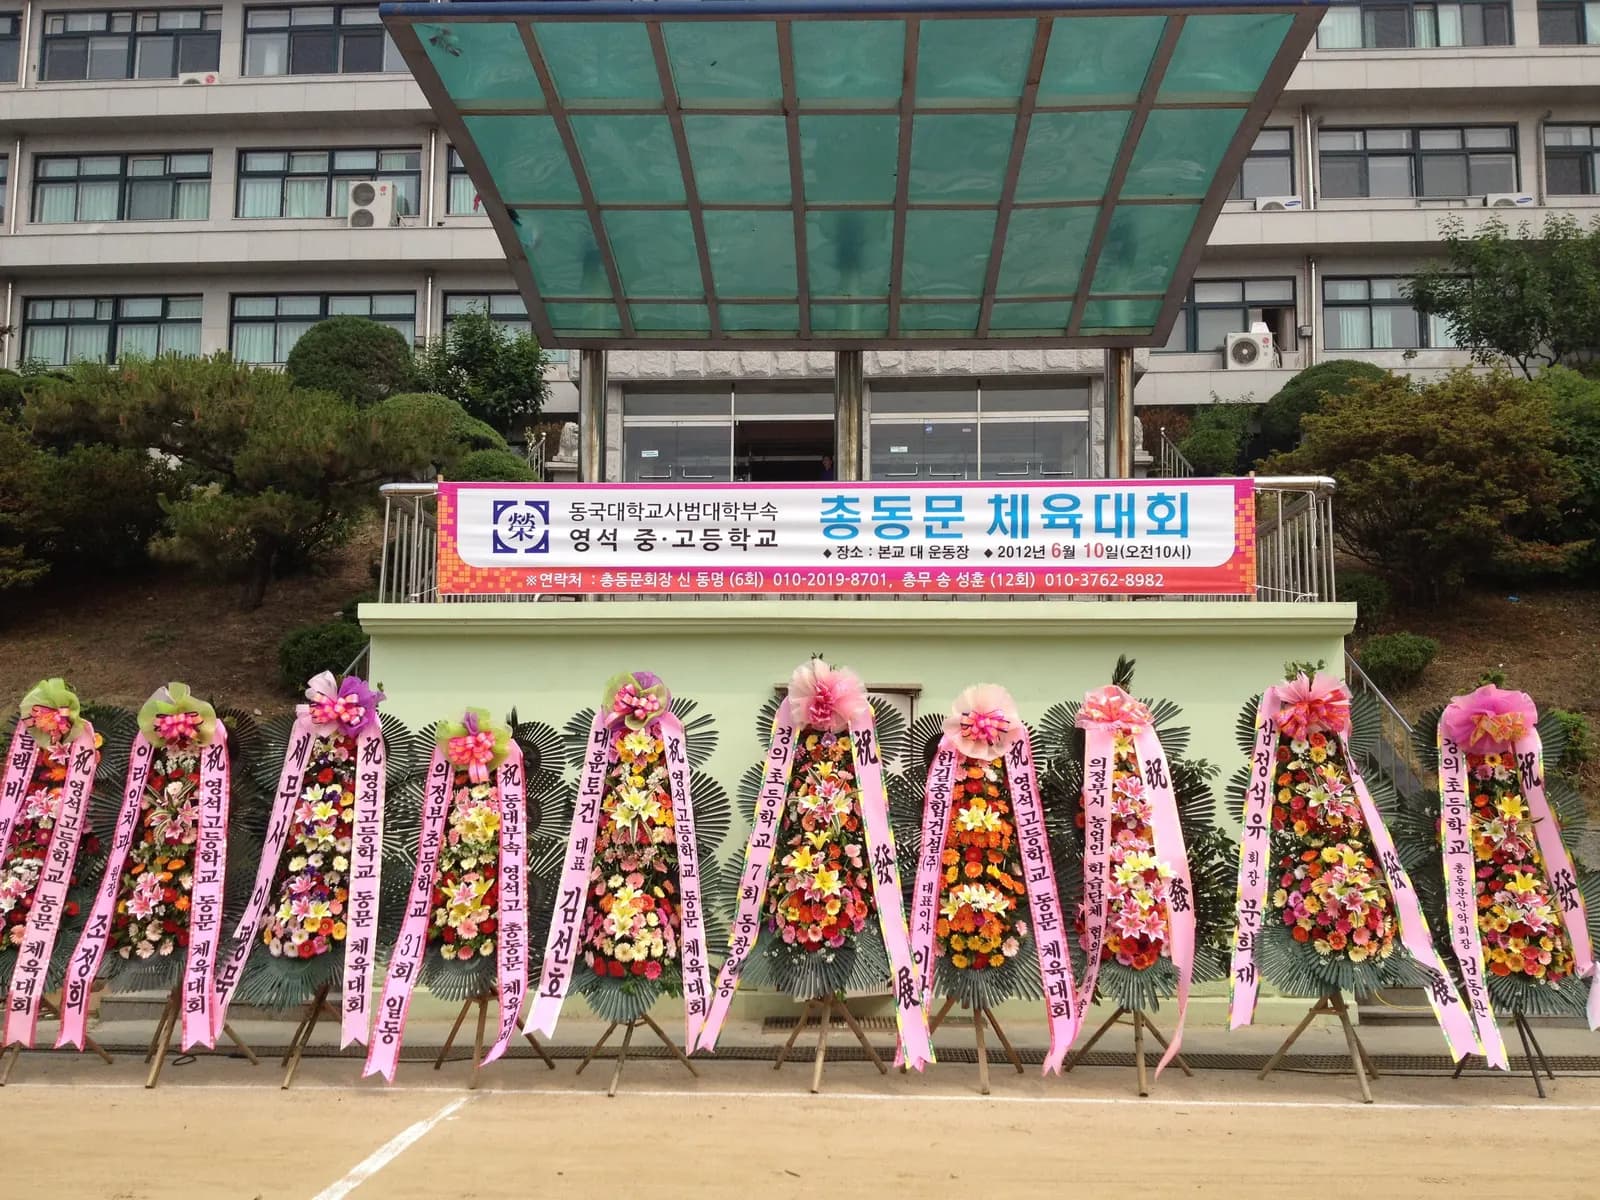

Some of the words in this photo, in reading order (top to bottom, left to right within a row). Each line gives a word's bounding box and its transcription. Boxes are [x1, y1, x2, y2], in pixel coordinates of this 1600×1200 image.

[568, 501, 779, 523] 동국대학교사범대학부속
[820, 494, 966, 541] 총동문
[987, 491, 1190, 540] 체육대회
[569, 527, 619, 553] 영석
[633, 527, 779, 553] 중·고등학교
[836, 545, 865, 560] 장소
[877, 545, 906, 560] 본교
[910, 545, 924, 560] 대
[927, 545, 970, 560] 운동장
[997, 545, 1046, 560] 2012년
[1051, 542, 1076, 560] 6월
[599, 572, 673, 588] 총동문회장
[677, 572, 690, 588] 신
[695, 572, 724, 588] 동명
[729, 572, 764, 588] (6회)
[902, 571, 932, 588] 총무
[936, 571, 951, 588] 송
[956, 571, 985, 588] 성훈
[990, 572, 1036, 588] (12회)
[1045, 573, 1164, 587] 010-3762-8982
[751, 726, 793, 850] 경의초등학교
[1088, 757, 1107, 808] 의정부시
[44, 779, 85, 884] 영석고등학교
[200, 778, 223, 884] 영석고등학교
[356, 771, 379, 878] 영석고등학교
[410, 760, 449, 918] 의정부초등학교
[501, 793, 522, 857] 동대부속
[671, 769, 697, 879] 영석고등학교
[1013, 773, 1050, 882] 영석고등학교
[570, 837, 588, 871] 대표
[31, 894, 57, 930] 동문
[195, 894, 217, 931] 동문
[352, 890, 374, 928] 동문
[501, 864, 522, 913] 영석고
[682, 889, 699, 928] 동문
[1033, 893, 1058, 931] 동문
[392, 933, 420, 983] 31회
[501, 921, 523, 971] 총동문
[540, 886, 582, 999] 김선호
[12, 940, 46, 1015] 체육대회
[187, 940, 211, 1015] 체육대회
[347, 937, 369, 1014] 체육대회
[684, 939, 707, 1017] 체육대회
[1042, 940, 1071, 1019] 체육대회
[378, 996, 403, 1044] 일동
